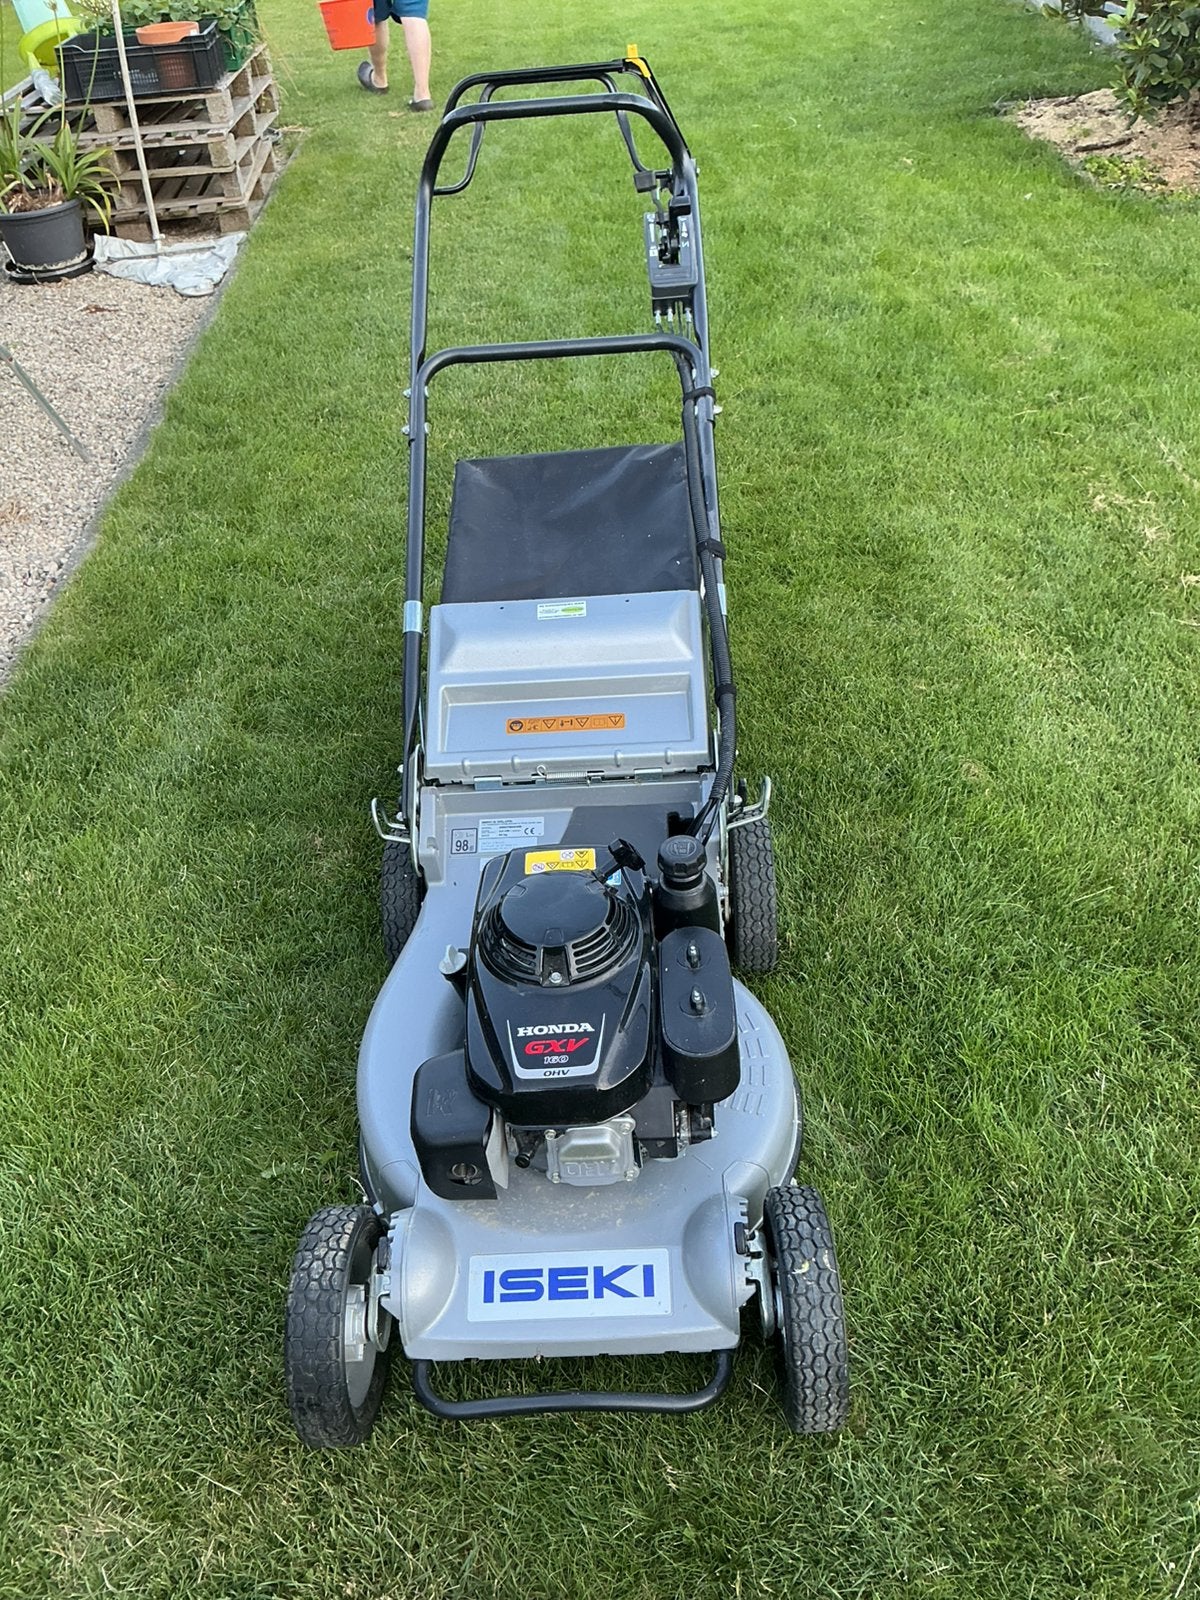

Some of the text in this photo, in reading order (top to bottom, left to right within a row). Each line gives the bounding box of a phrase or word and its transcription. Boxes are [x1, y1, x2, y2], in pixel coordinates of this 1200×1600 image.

[524, 827, 535, 835] CE
[455, 840, 469, 852] 98
[517, 1023, 595, 1037] HONDA
[524, 1037, 590, 1055] GXV
[543, 1055, 569, 1065] 160
[543, 1069, 570, 1077] OHV
[483, 1264, 655, 1304] ISEKI
